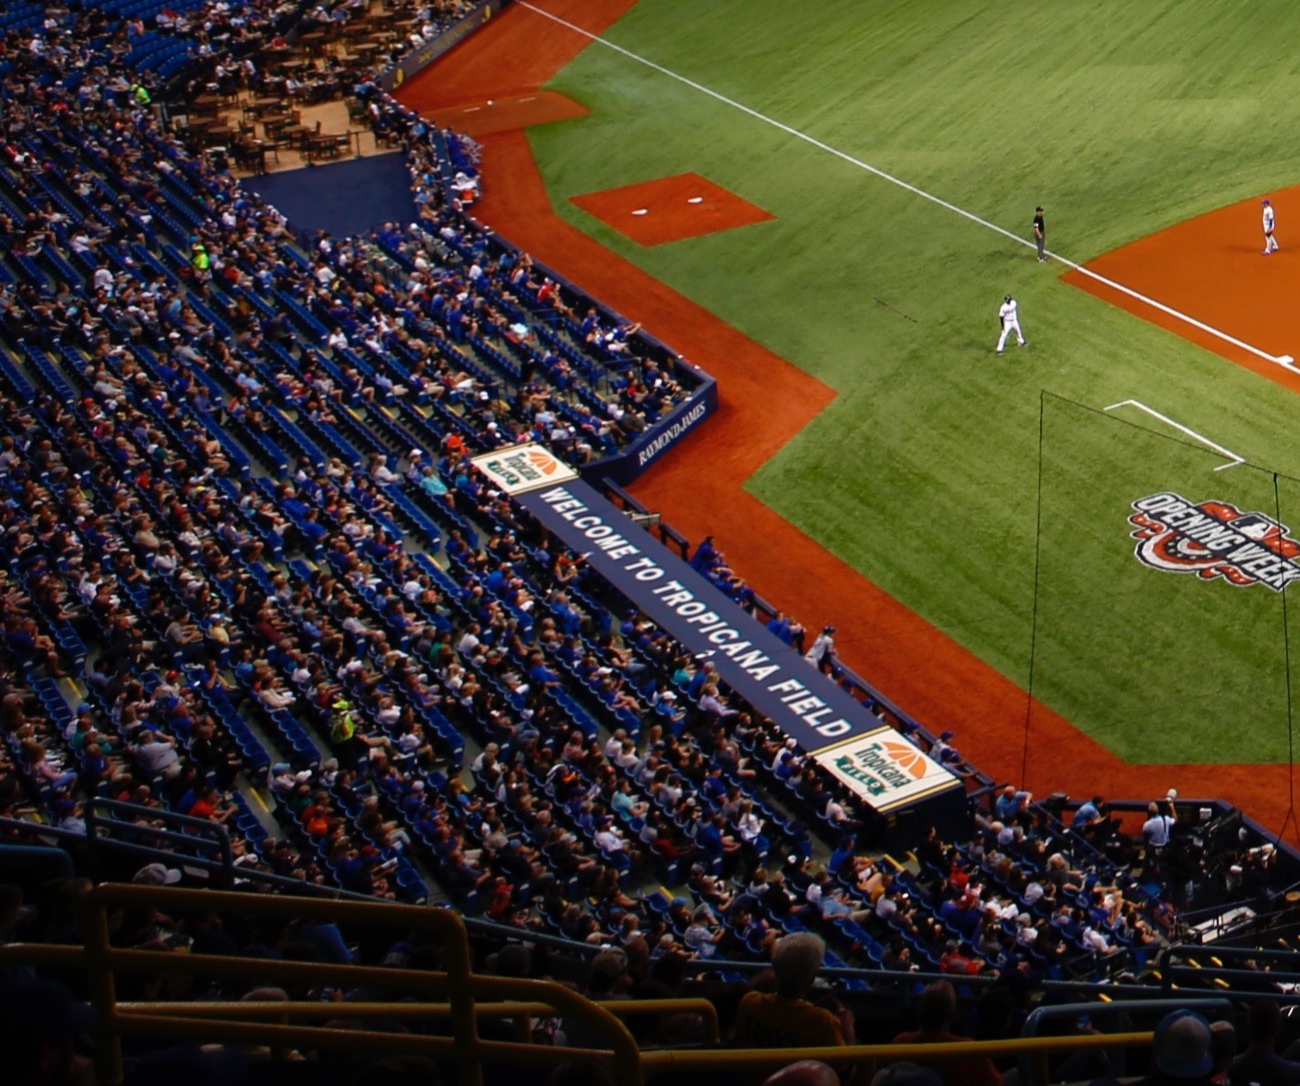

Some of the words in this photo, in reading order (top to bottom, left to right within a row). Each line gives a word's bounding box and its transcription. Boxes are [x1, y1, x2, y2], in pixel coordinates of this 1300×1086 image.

[638, 421, 681, 466] RAYMOND
[679, 400, 706, 434] JAMES
[1137, 493, 1246, 551] OPENING
[539, 485, 627, 561] WELCOME
[625, 551, 664, 582] TO
[653, 582, 781, 683] TROPICANA
[767, 679, 853, 739] FIELD
[854, 742, 913, 789] Tropicana
